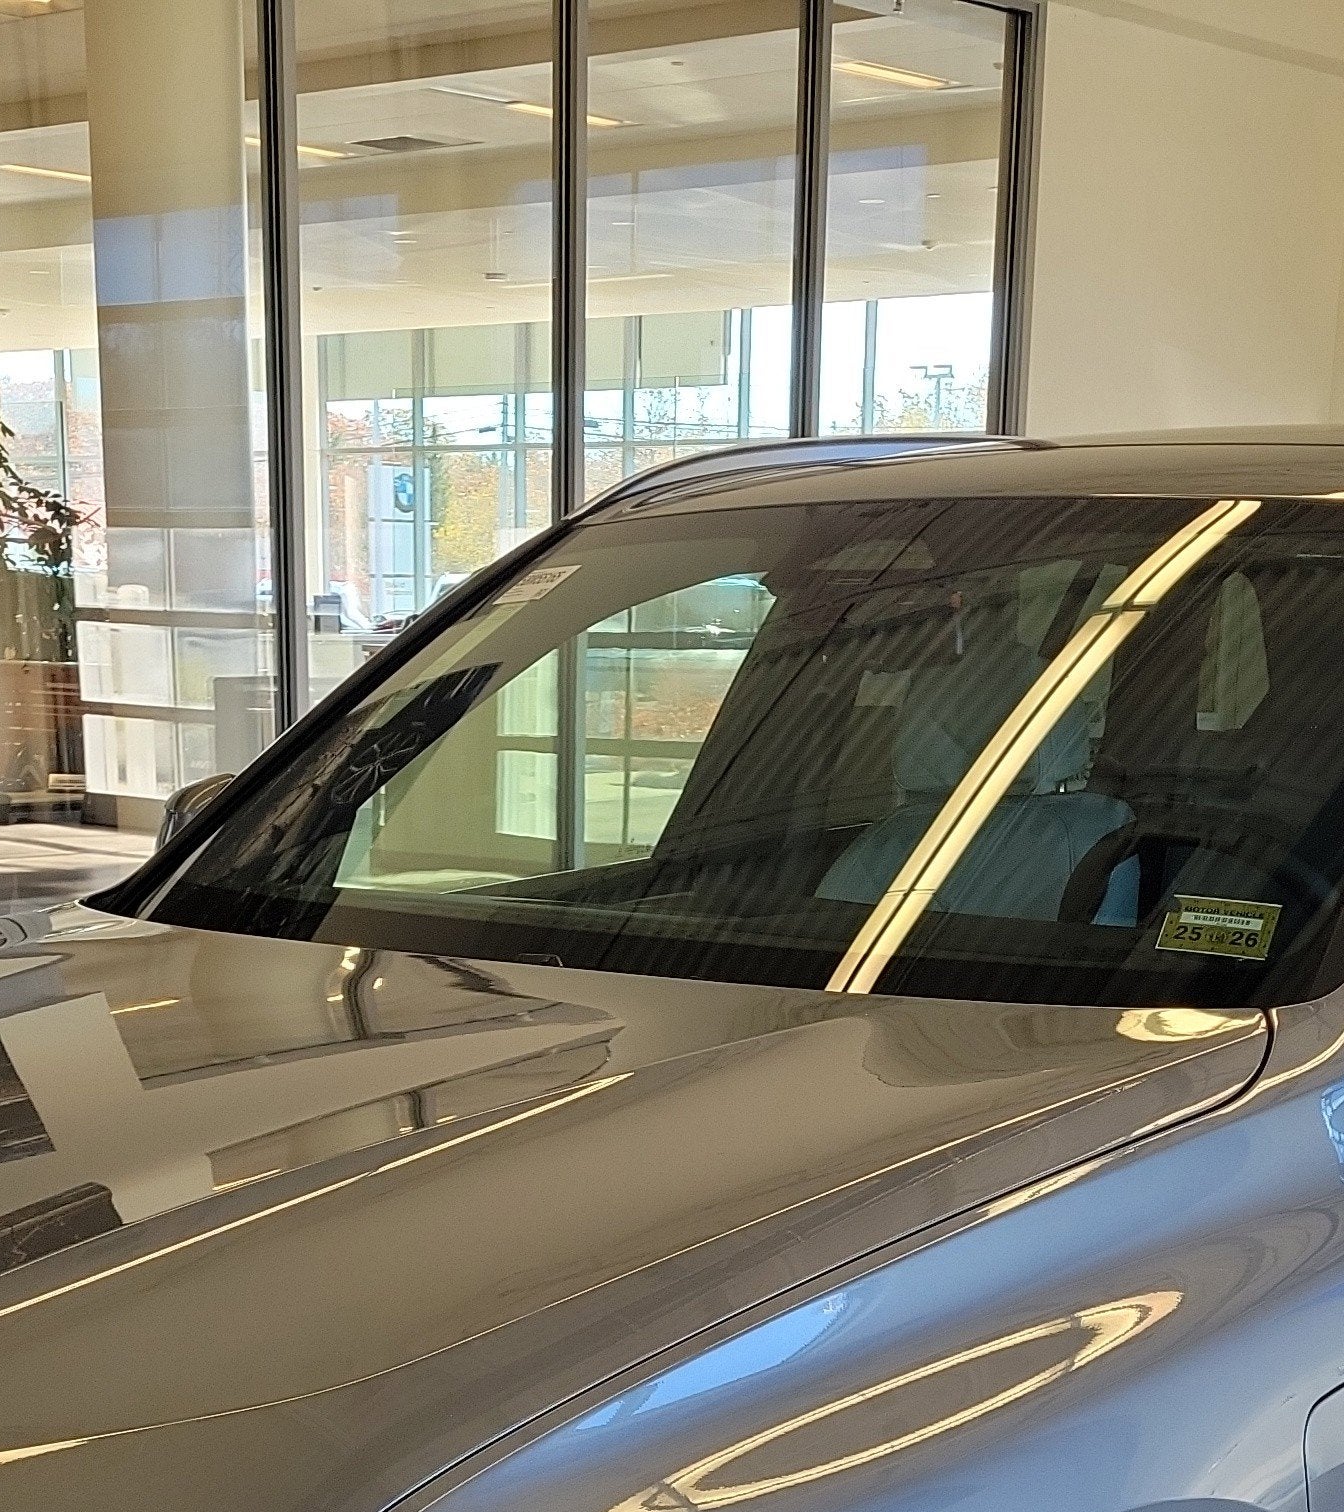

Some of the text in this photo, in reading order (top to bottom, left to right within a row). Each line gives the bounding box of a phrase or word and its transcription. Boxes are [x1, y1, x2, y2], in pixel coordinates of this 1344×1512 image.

[1184, 906, 1264, 919] MOTOR VEHICLE
[1173, 925, 1259, 948] 25 26
